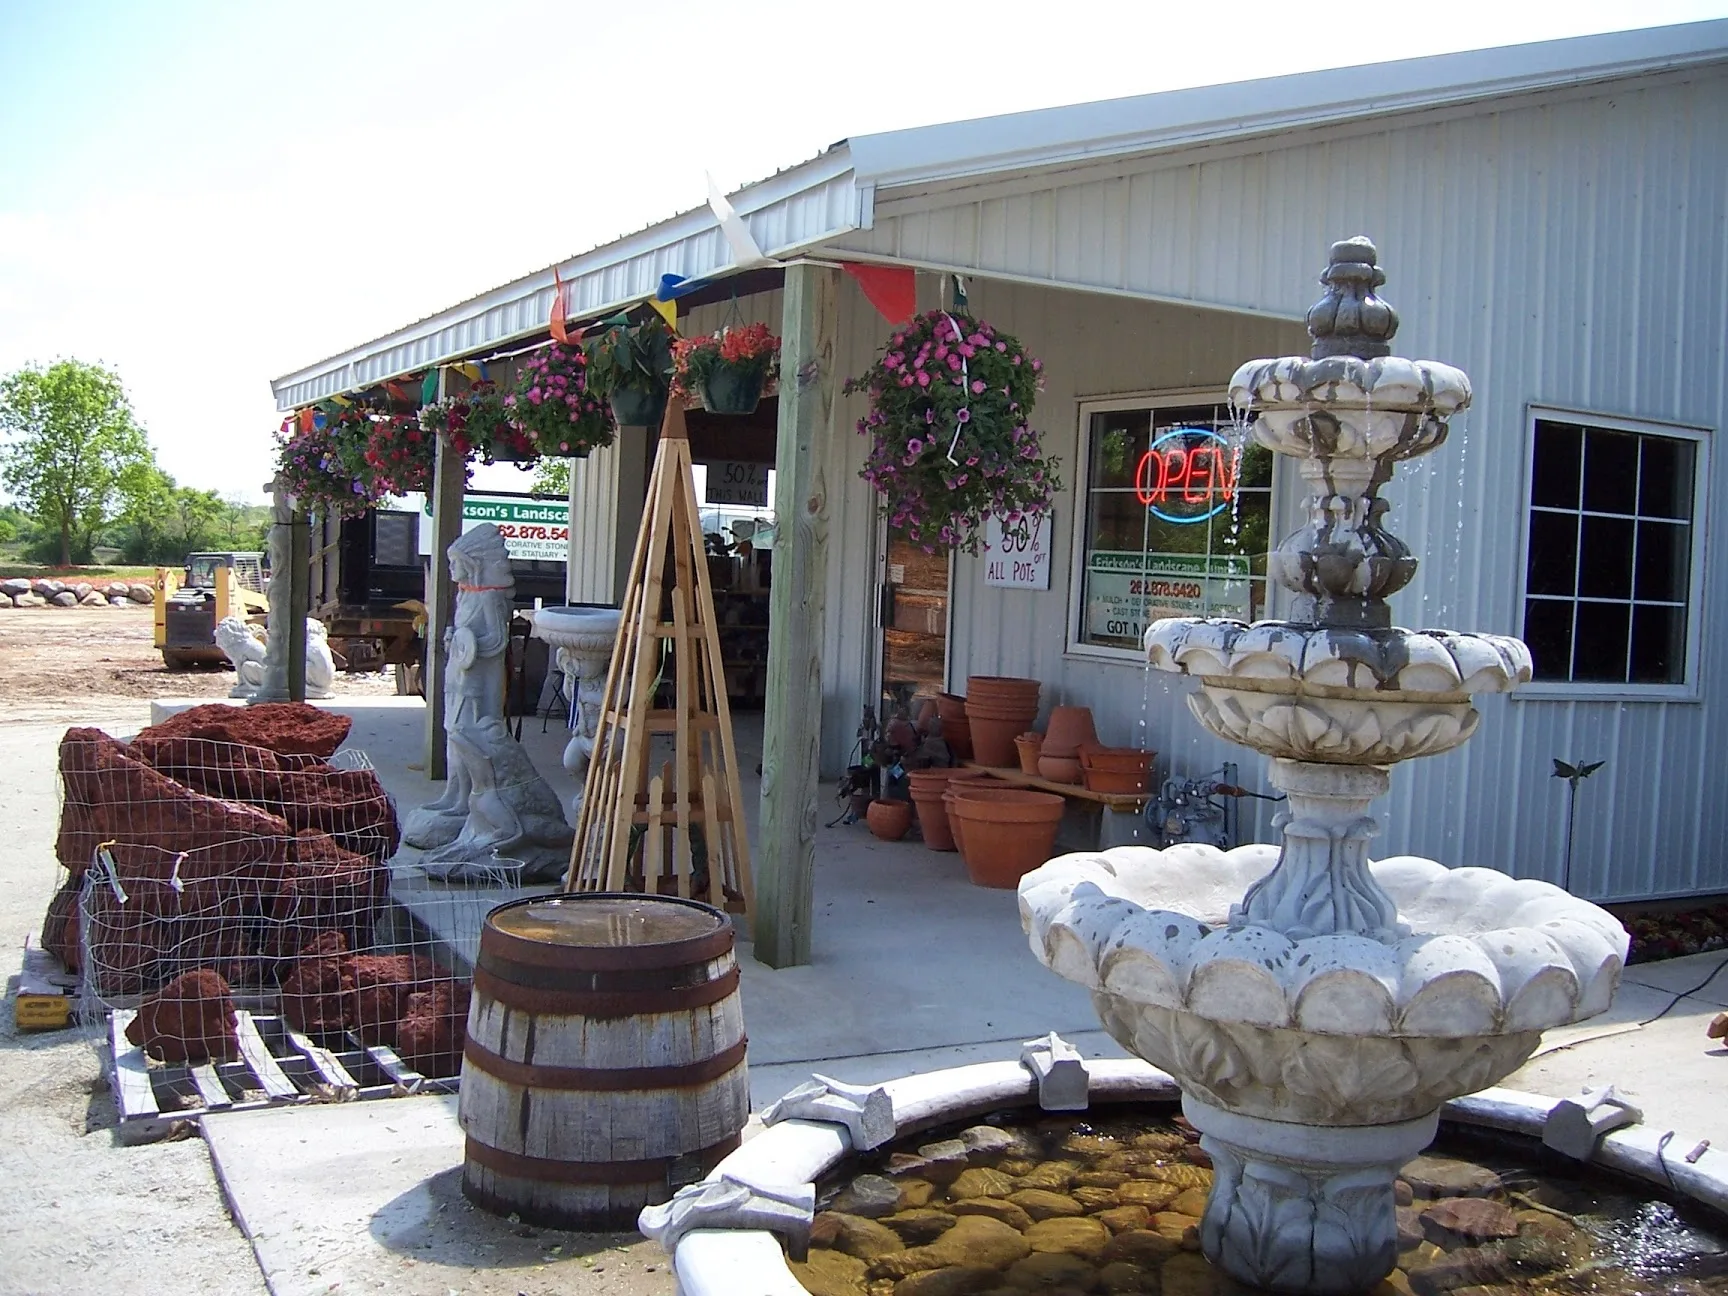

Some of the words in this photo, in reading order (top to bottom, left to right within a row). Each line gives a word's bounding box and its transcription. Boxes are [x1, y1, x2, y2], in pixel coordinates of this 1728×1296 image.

[723, 463, 756, 485] 50%
[1136, 446, 1239, 505] OPEN
[708, 488, 732, 501] THIS
[739, 490, 764, 503] WALL
[522, 550, 559, 559] STATUARY
[988, 562, 1005, 579] ALL
[1130, 580, 1200, 598] 262.878.5420
[1131, 597, 1169, 608] DEORATIVE
[1107, 620, 1129, 636] GOT
